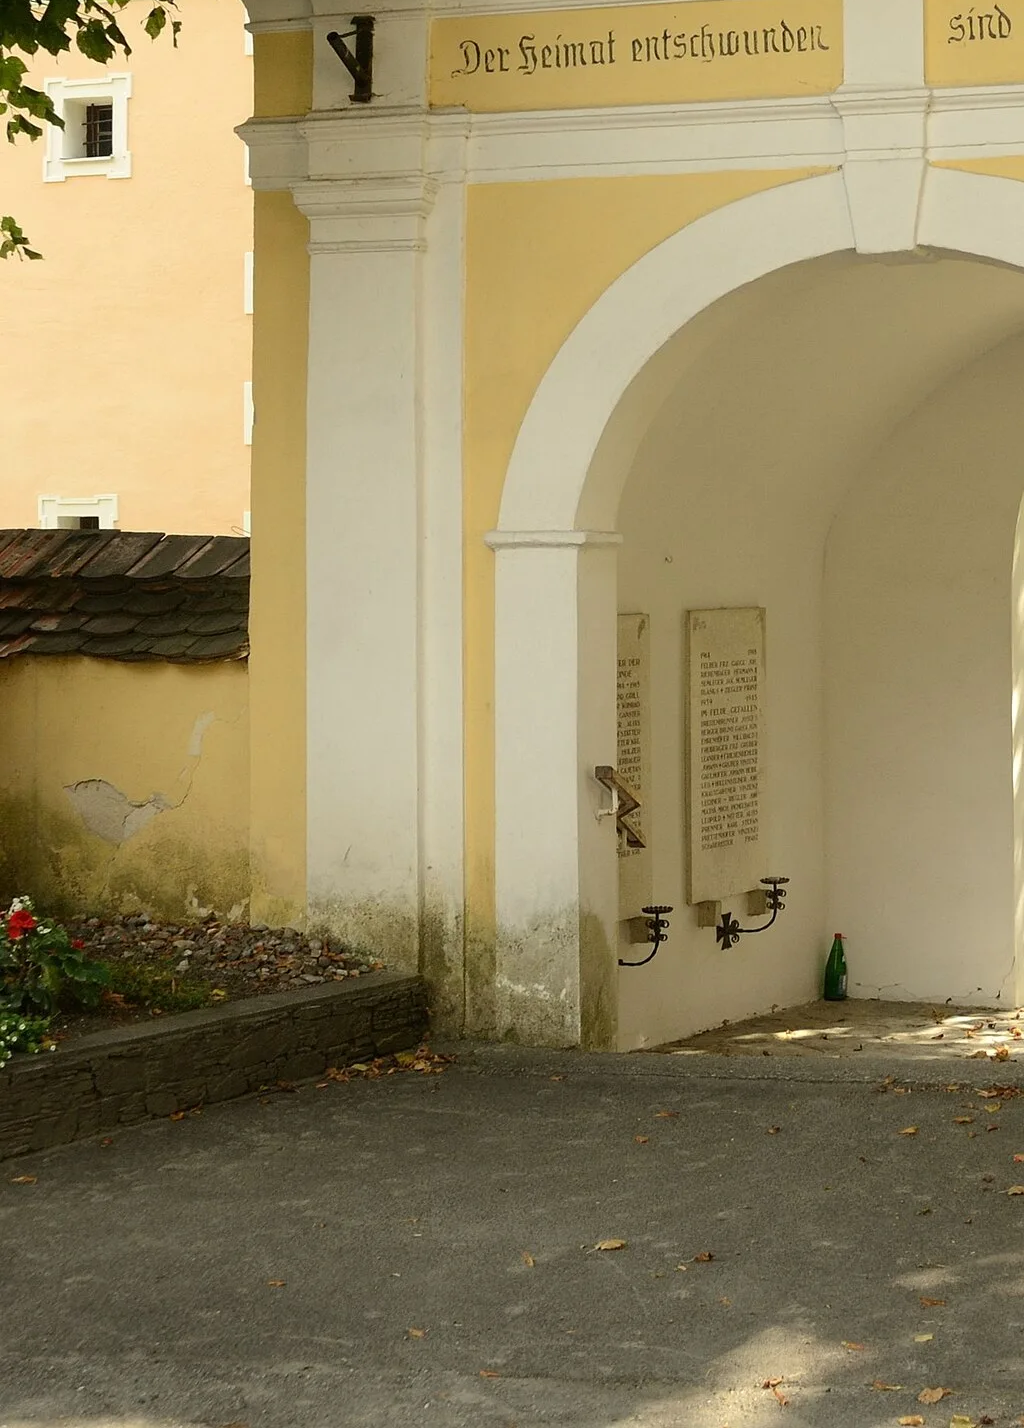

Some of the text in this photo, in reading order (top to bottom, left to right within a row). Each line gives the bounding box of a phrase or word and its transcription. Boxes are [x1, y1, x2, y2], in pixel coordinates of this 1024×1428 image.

[948, 4, 1012, 44] sind
[451, 20, 830, 78] Der Heimat entschwunden
